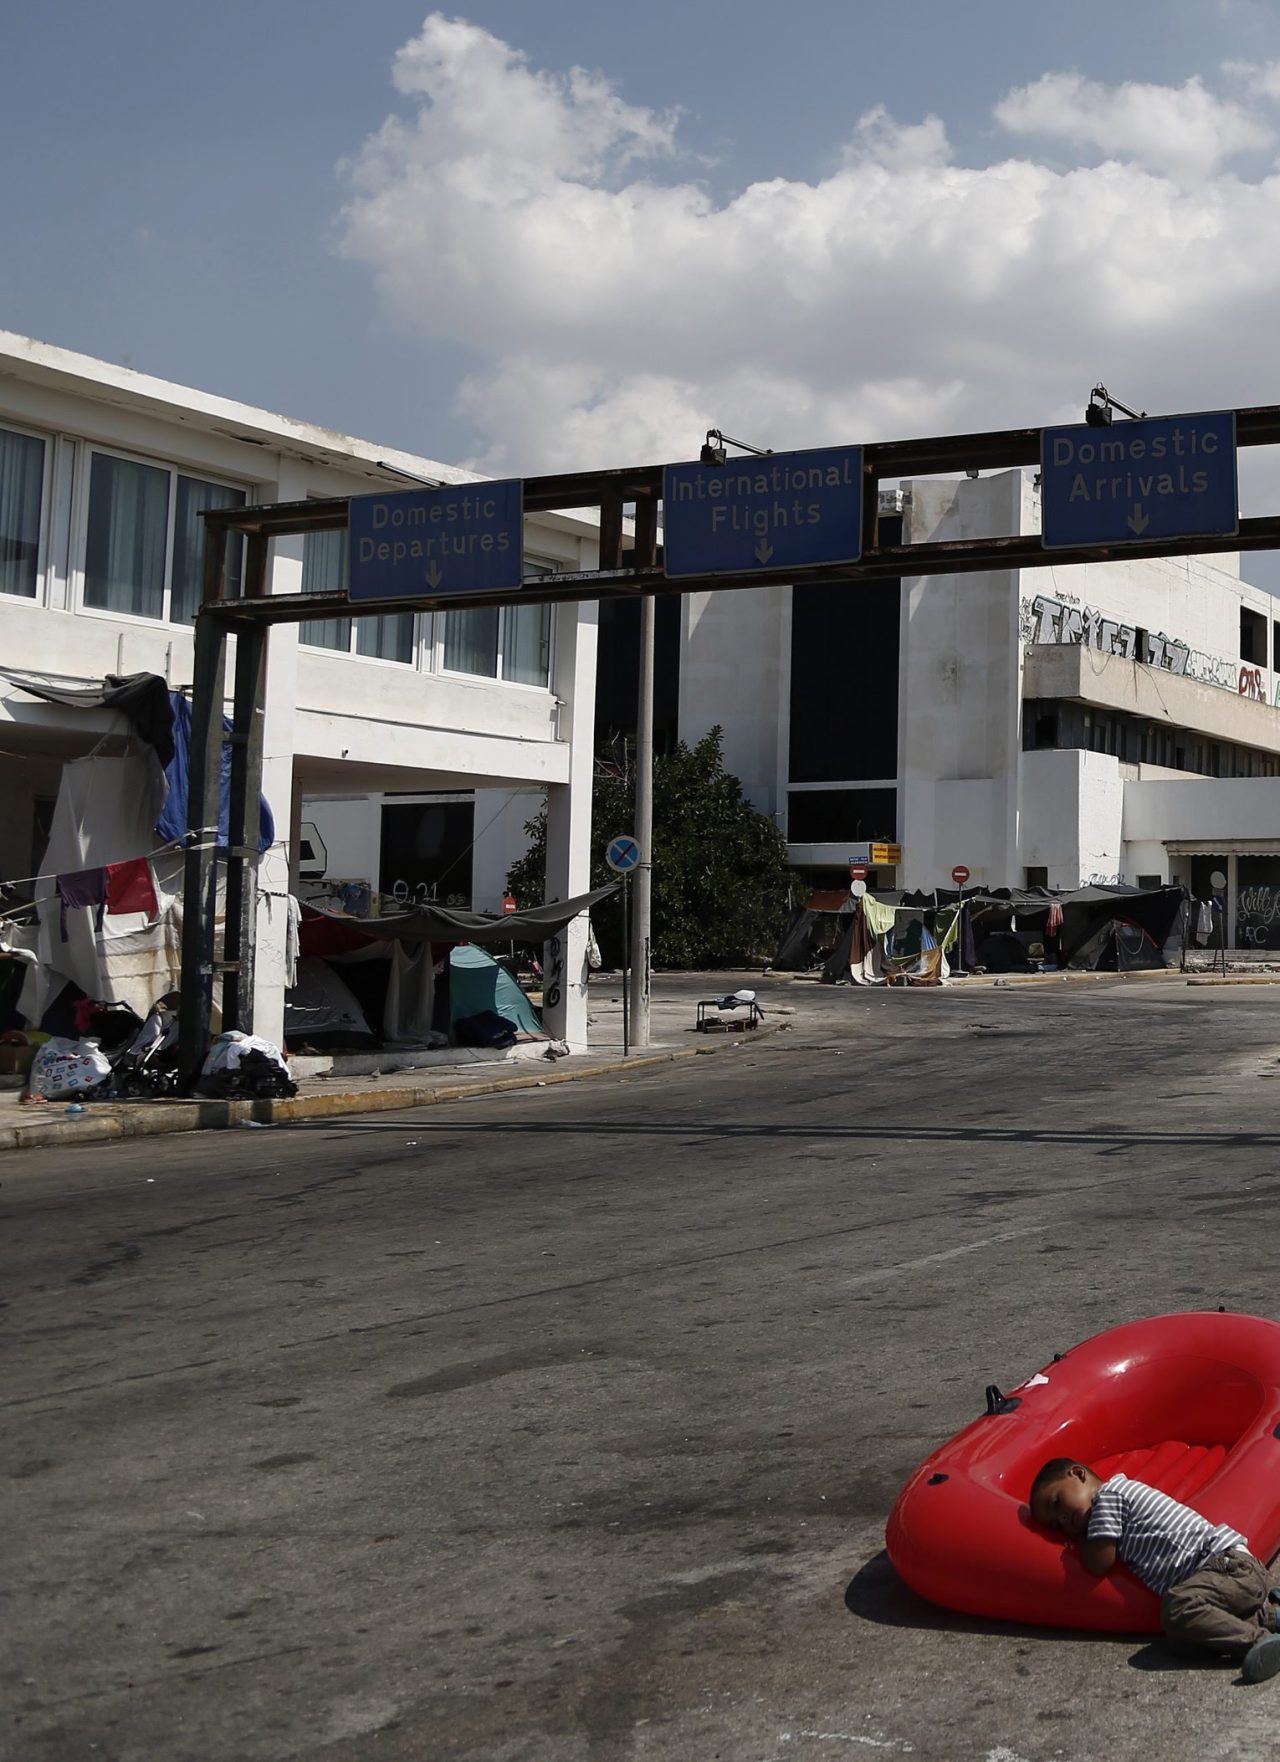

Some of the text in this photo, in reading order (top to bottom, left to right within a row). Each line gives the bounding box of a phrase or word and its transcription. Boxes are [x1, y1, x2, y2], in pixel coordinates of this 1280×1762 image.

[1052, 428, 1219, 467] Domestic
[671, 458, 852, 501] International
[1068, 465, 1210, 501] Arrivals
[371, 498, 496, 530] Domestic
[712, 500, 822, 536] Flights
[358, 527, 511, 566] Departures
